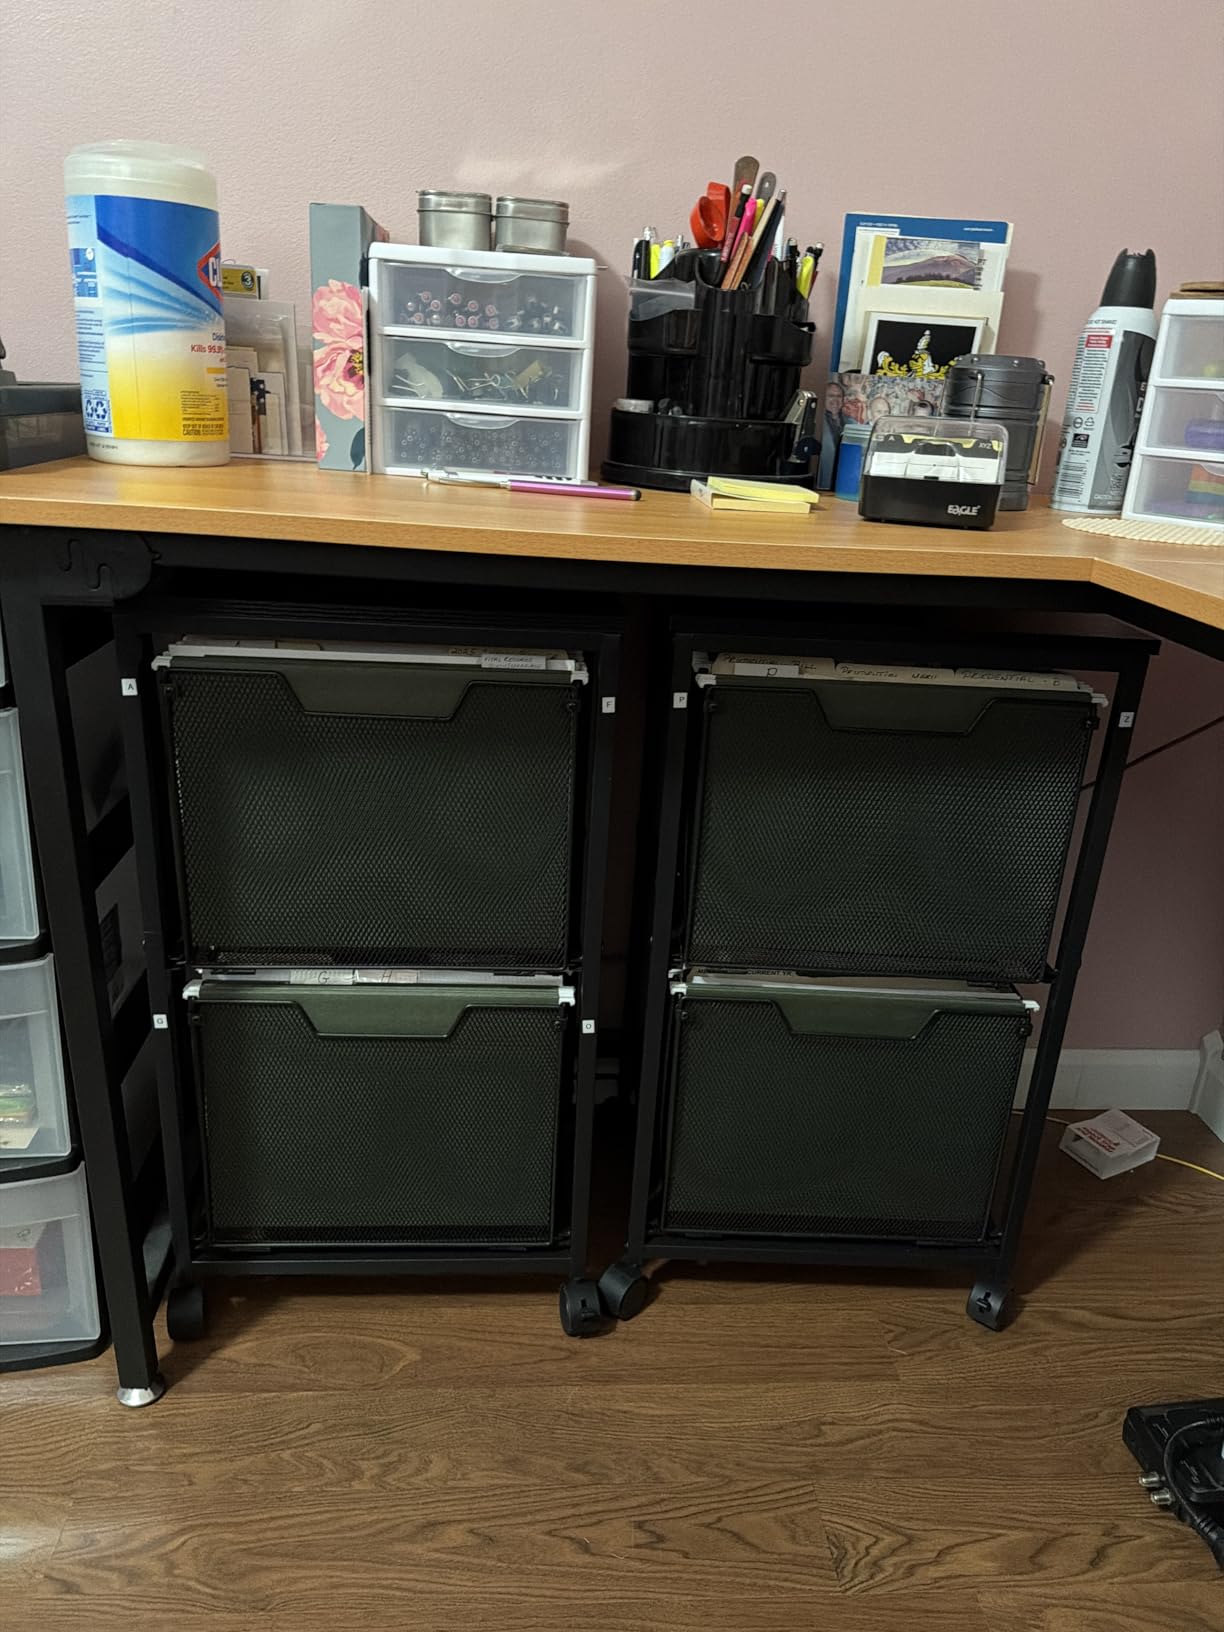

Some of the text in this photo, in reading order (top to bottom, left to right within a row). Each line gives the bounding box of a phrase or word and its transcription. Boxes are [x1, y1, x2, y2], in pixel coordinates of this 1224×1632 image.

[243, 272, 253, 289] 3
[190, 344, 207, 353] Kills
[978, 442, 992, 450] XYZ
[947, 504, 979, 516] EAGLE
[1122, 715, 1130, 723] Z
[318, 970, 330, 984] G
[381, 969, 393, 984] H
[746, 969, 780, 977] CURRENT
